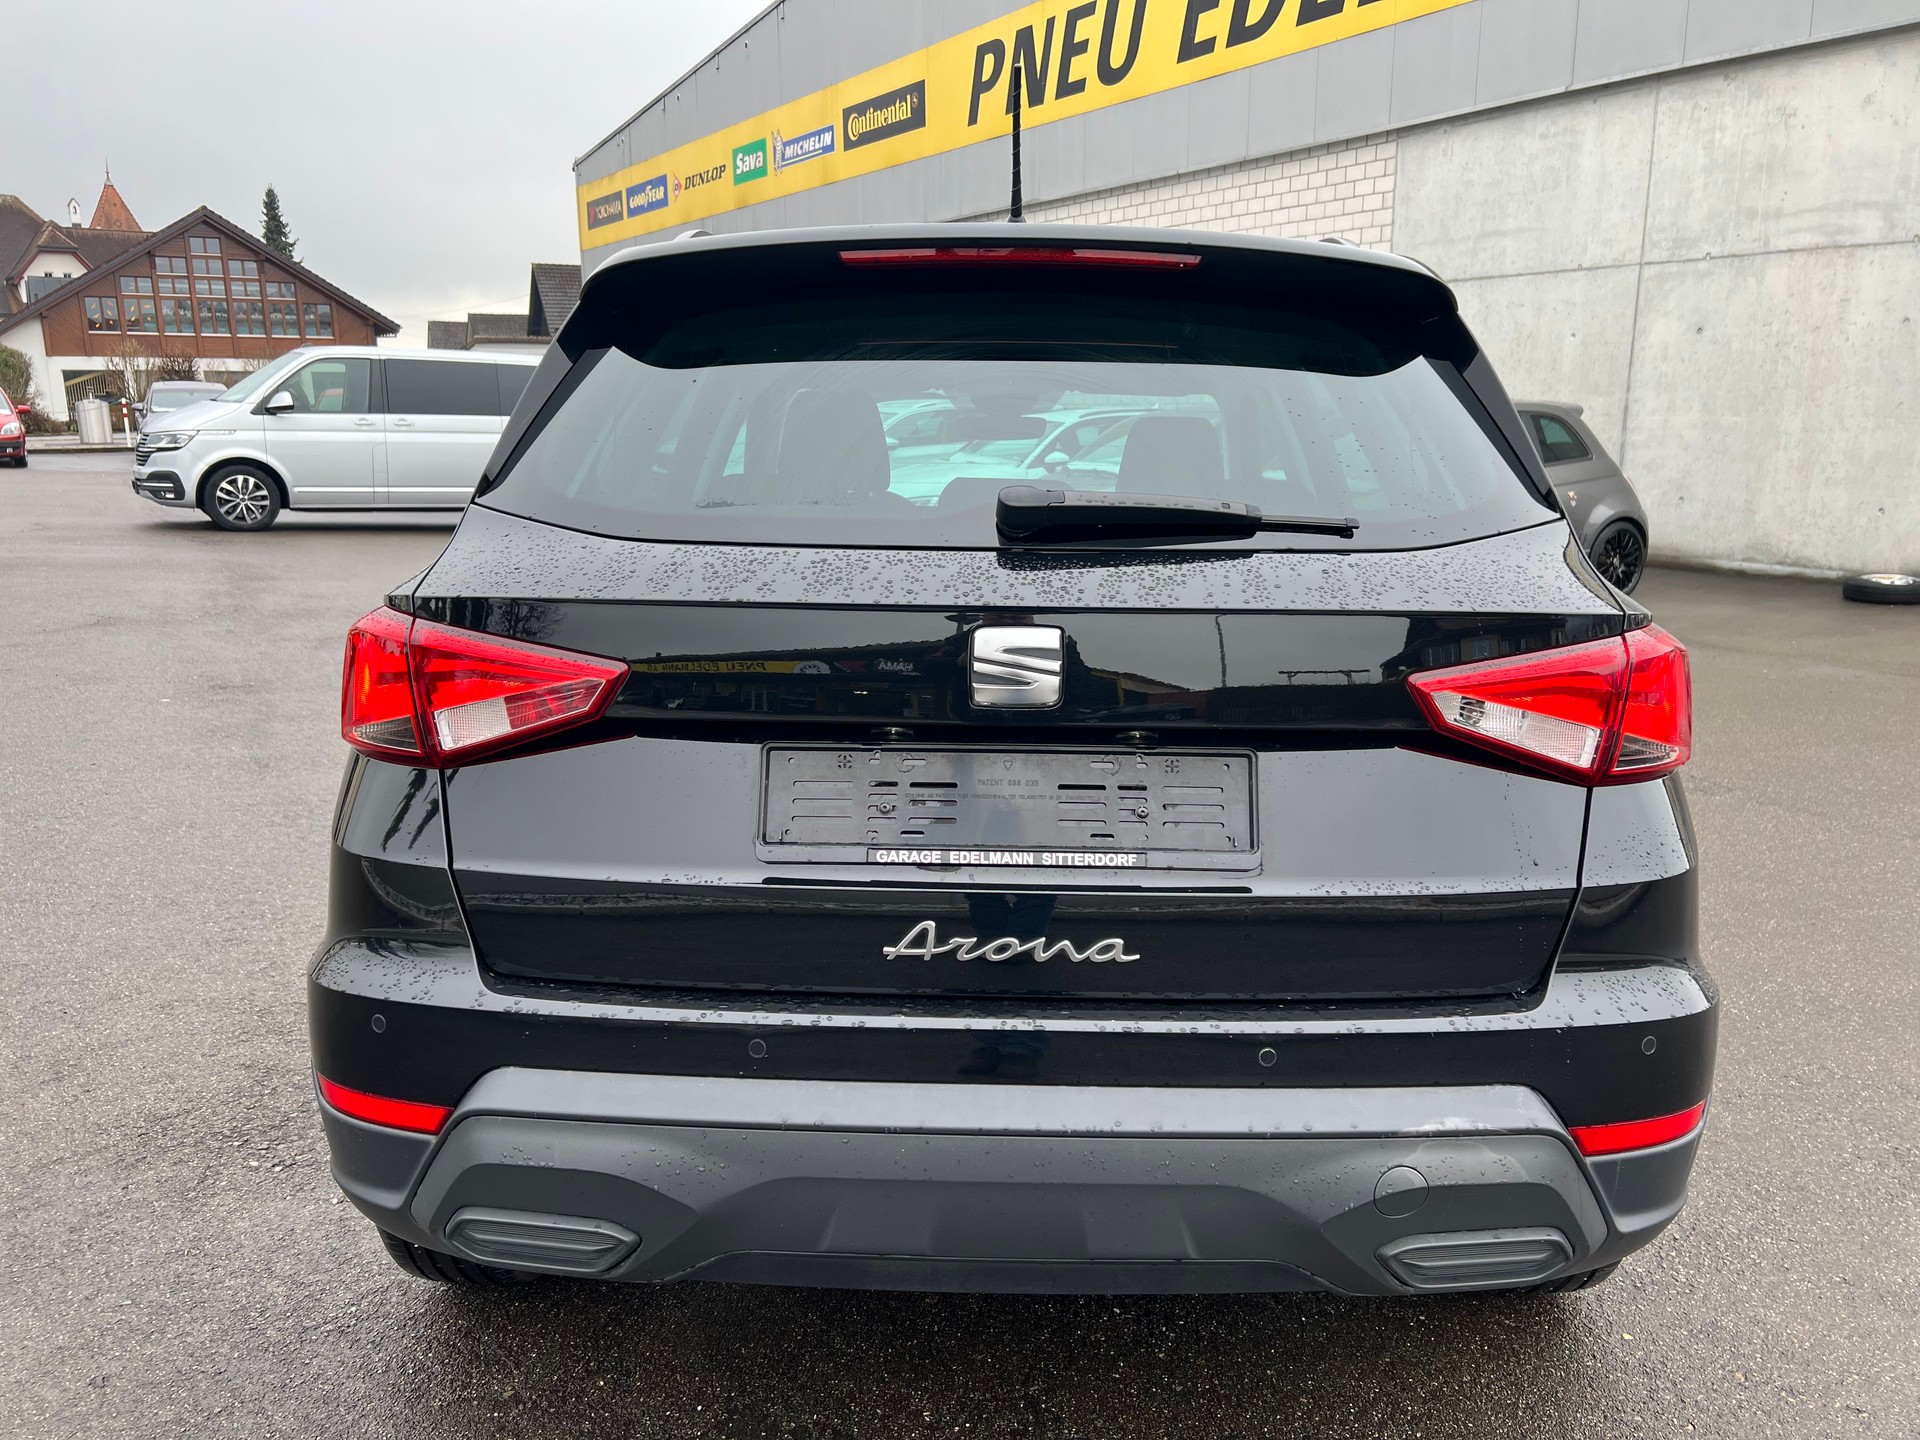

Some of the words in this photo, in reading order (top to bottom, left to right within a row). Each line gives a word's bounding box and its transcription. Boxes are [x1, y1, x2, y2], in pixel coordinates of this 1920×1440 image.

[967, 0, 1147, 127] PNEU
[848, 94, 912, 141] Continental
[784, 131, 833, 159] MICHELIN
[736, 151, 763, 175] Sava
[684, 164, 726, 190] DUNLOP
[629, 185, 665, 208] GOODYEAR
[977, 778, 1004, 787] PATENT
[875, 850, 942, 864] GARAGE
[949, 850, 1034, 865] EDELMANN
[1041, 852, 1138, 867] SITTERDORF
[882, 919, 1141, 963] Arona
